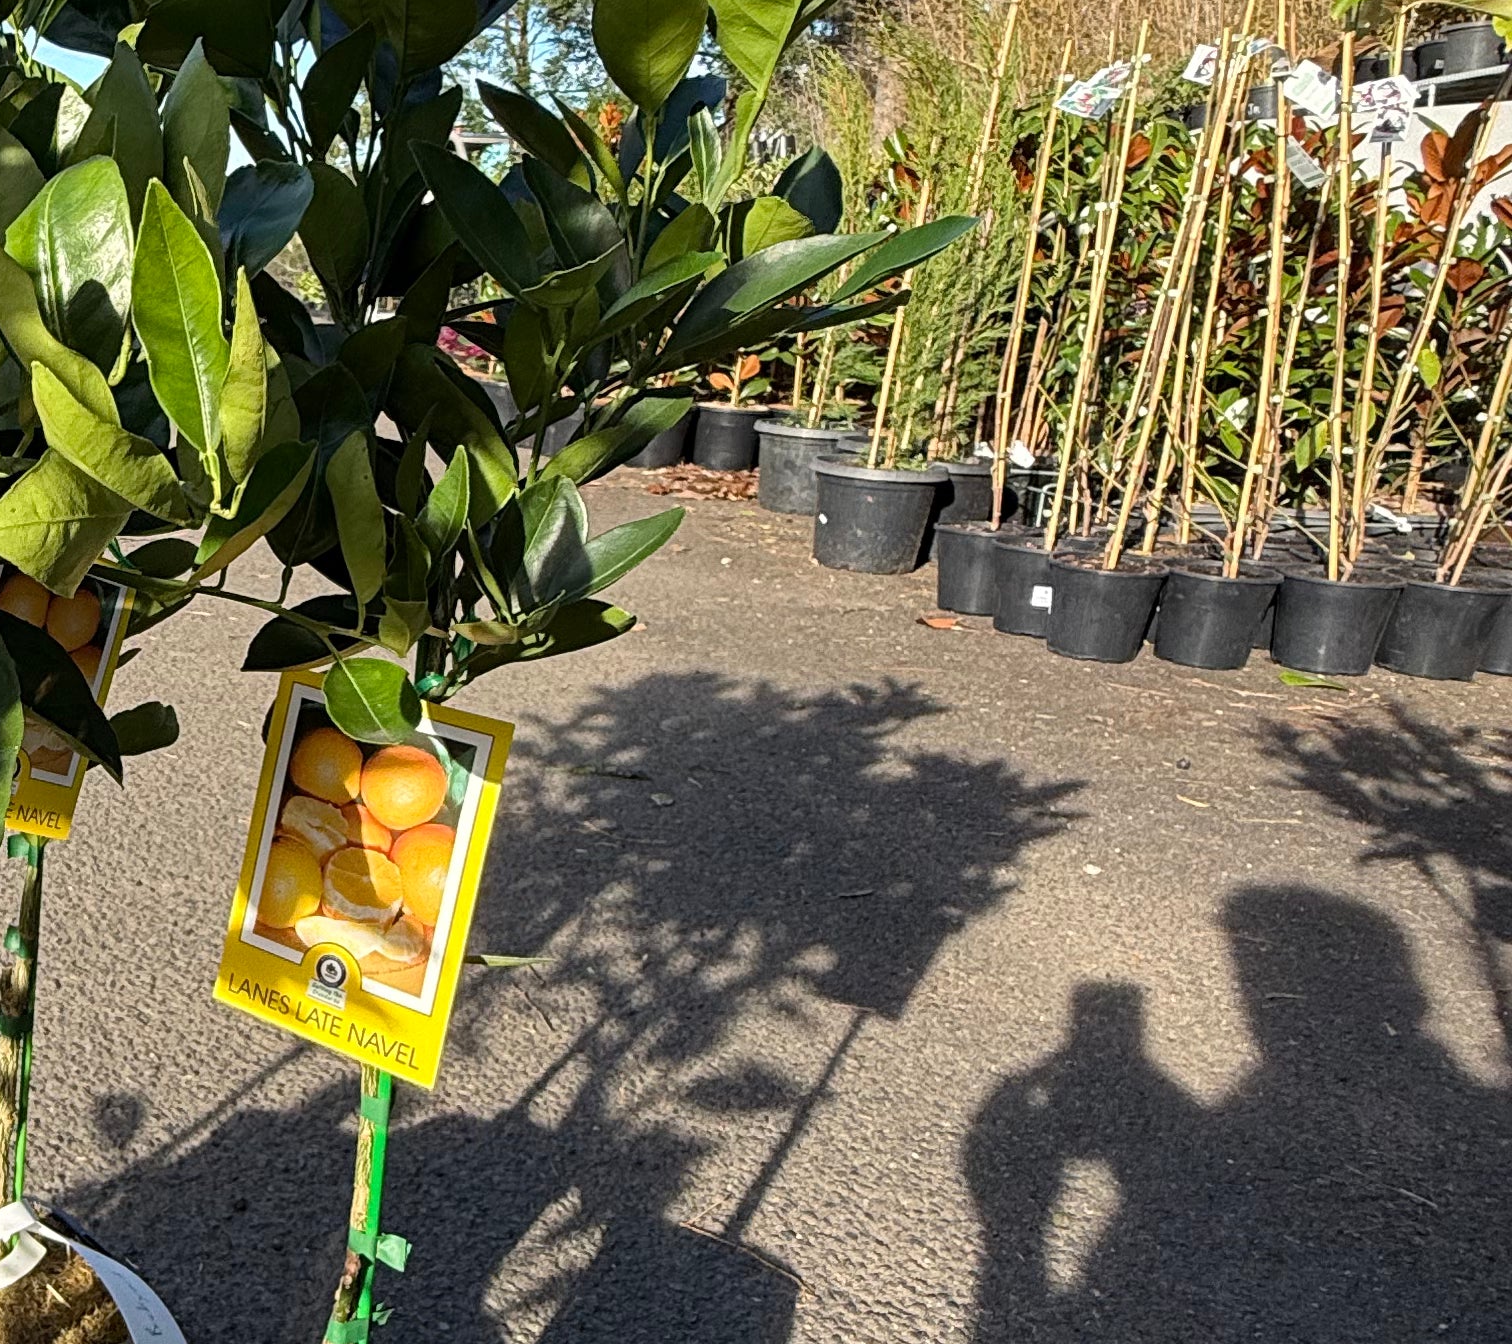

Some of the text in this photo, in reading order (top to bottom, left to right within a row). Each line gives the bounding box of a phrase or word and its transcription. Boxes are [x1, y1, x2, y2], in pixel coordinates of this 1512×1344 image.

[16, 805, 61, 830] NAVEL
[228, 972, 291, 1015] LANES
[295, 1001, 343, 1038] LATE
[347, 1022, 420, 1071] NAVEL
